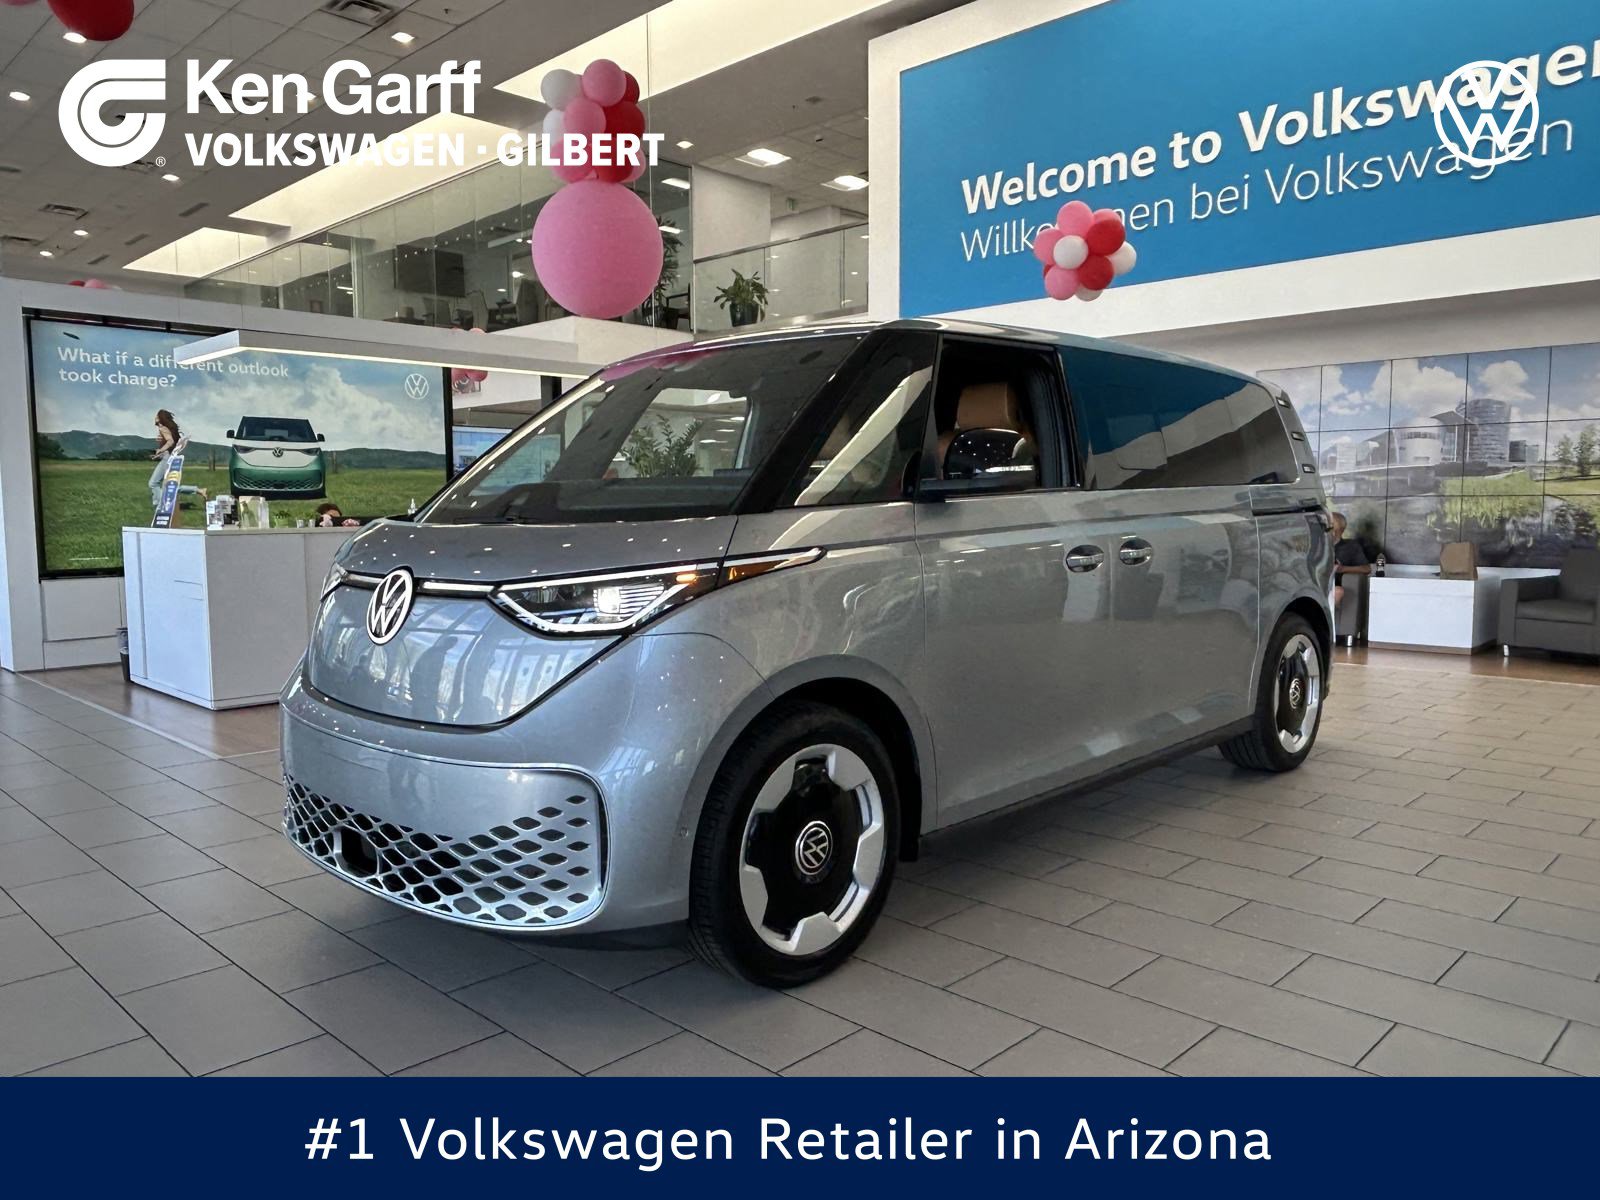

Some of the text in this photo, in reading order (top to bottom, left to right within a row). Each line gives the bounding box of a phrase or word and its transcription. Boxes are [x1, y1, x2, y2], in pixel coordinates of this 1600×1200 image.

[960, 119, 1573, 262] Willken bei Volkswagen
[961, 146, 1157, 215] Welcome
[1169, 130, 1222, 169] to
[57, 346, 111, 365] What
[115, 350, 128, 366] if
[133, 356, 144, 367] a
[228, 363, 289, 377] outlook
[59, 368, 177, 390] took charge?
